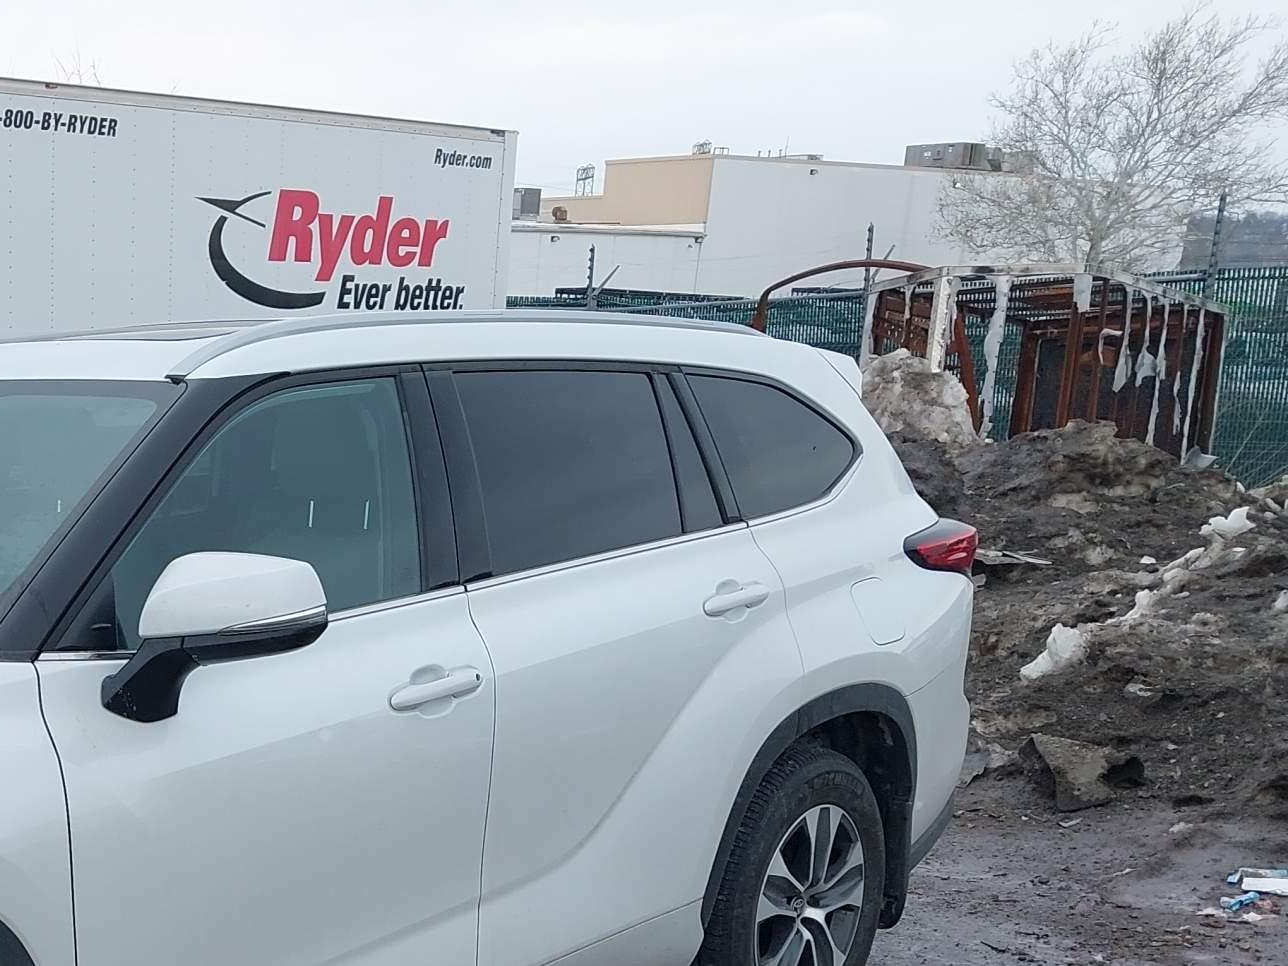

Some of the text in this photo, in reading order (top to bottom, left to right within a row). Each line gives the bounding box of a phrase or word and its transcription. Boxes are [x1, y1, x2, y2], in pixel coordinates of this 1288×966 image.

[434, 148, 493, 170] Ryder.com
[268, 189, 450, 283] Ryder
[336, 274, 465, 311] Ever better.
